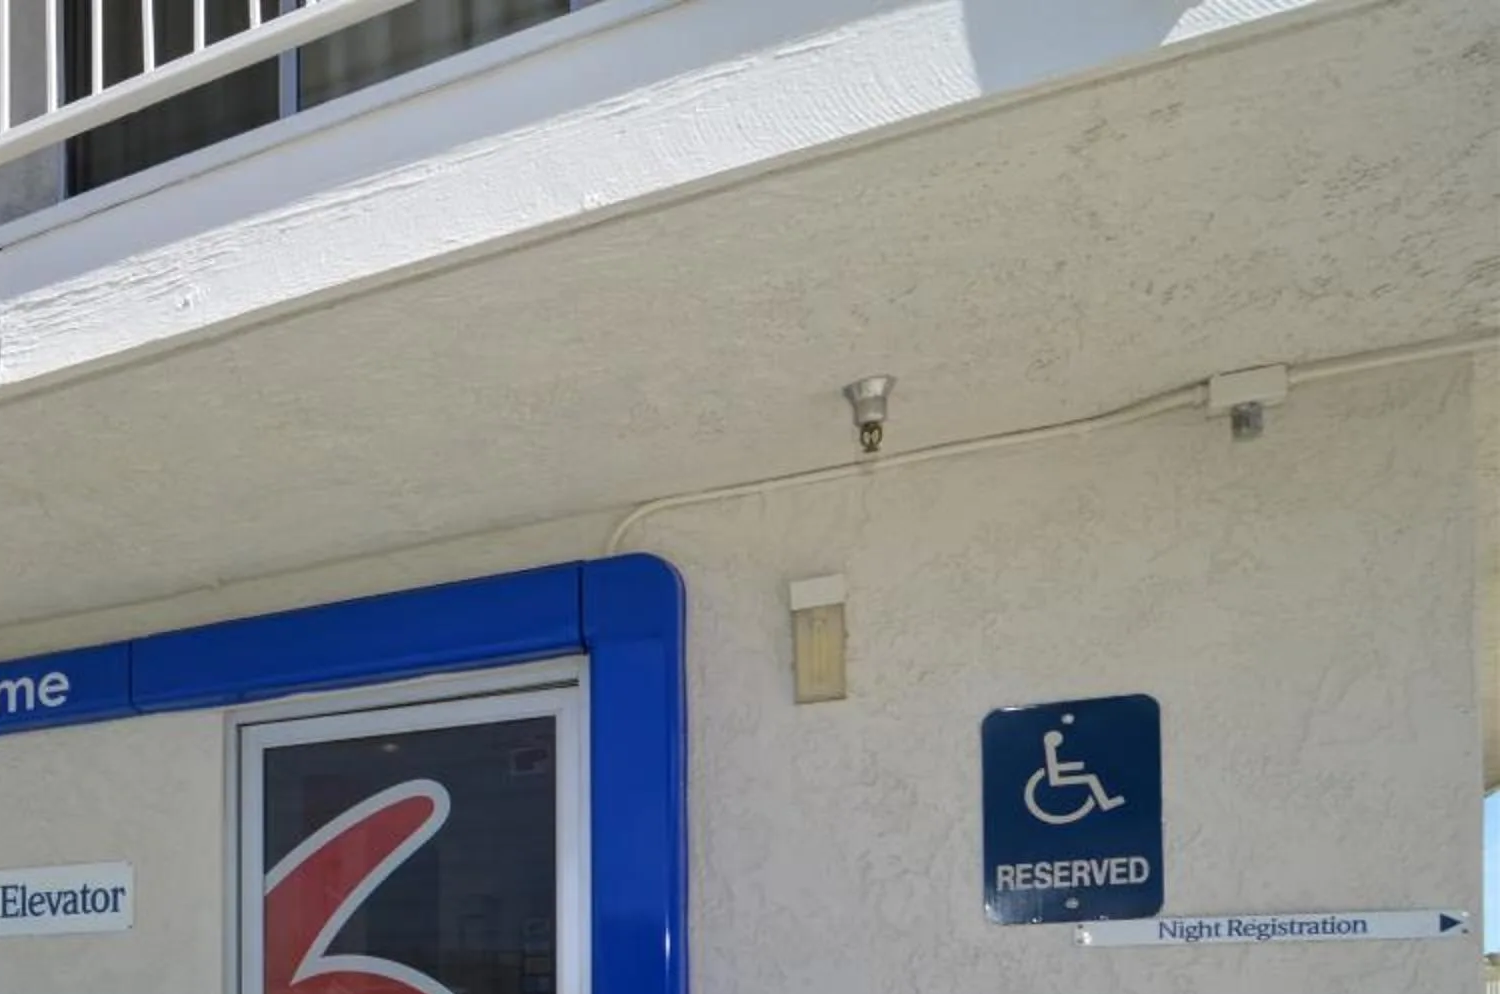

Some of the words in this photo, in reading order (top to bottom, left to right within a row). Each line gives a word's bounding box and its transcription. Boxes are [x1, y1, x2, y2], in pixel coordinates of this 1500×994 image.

[995, 857, 1151, 891] RESERVED
[0, 884, 126, 919] Elevator
[1158, 919, 1222, 942] Night
[1227, 916, 1368, 941] Registration
